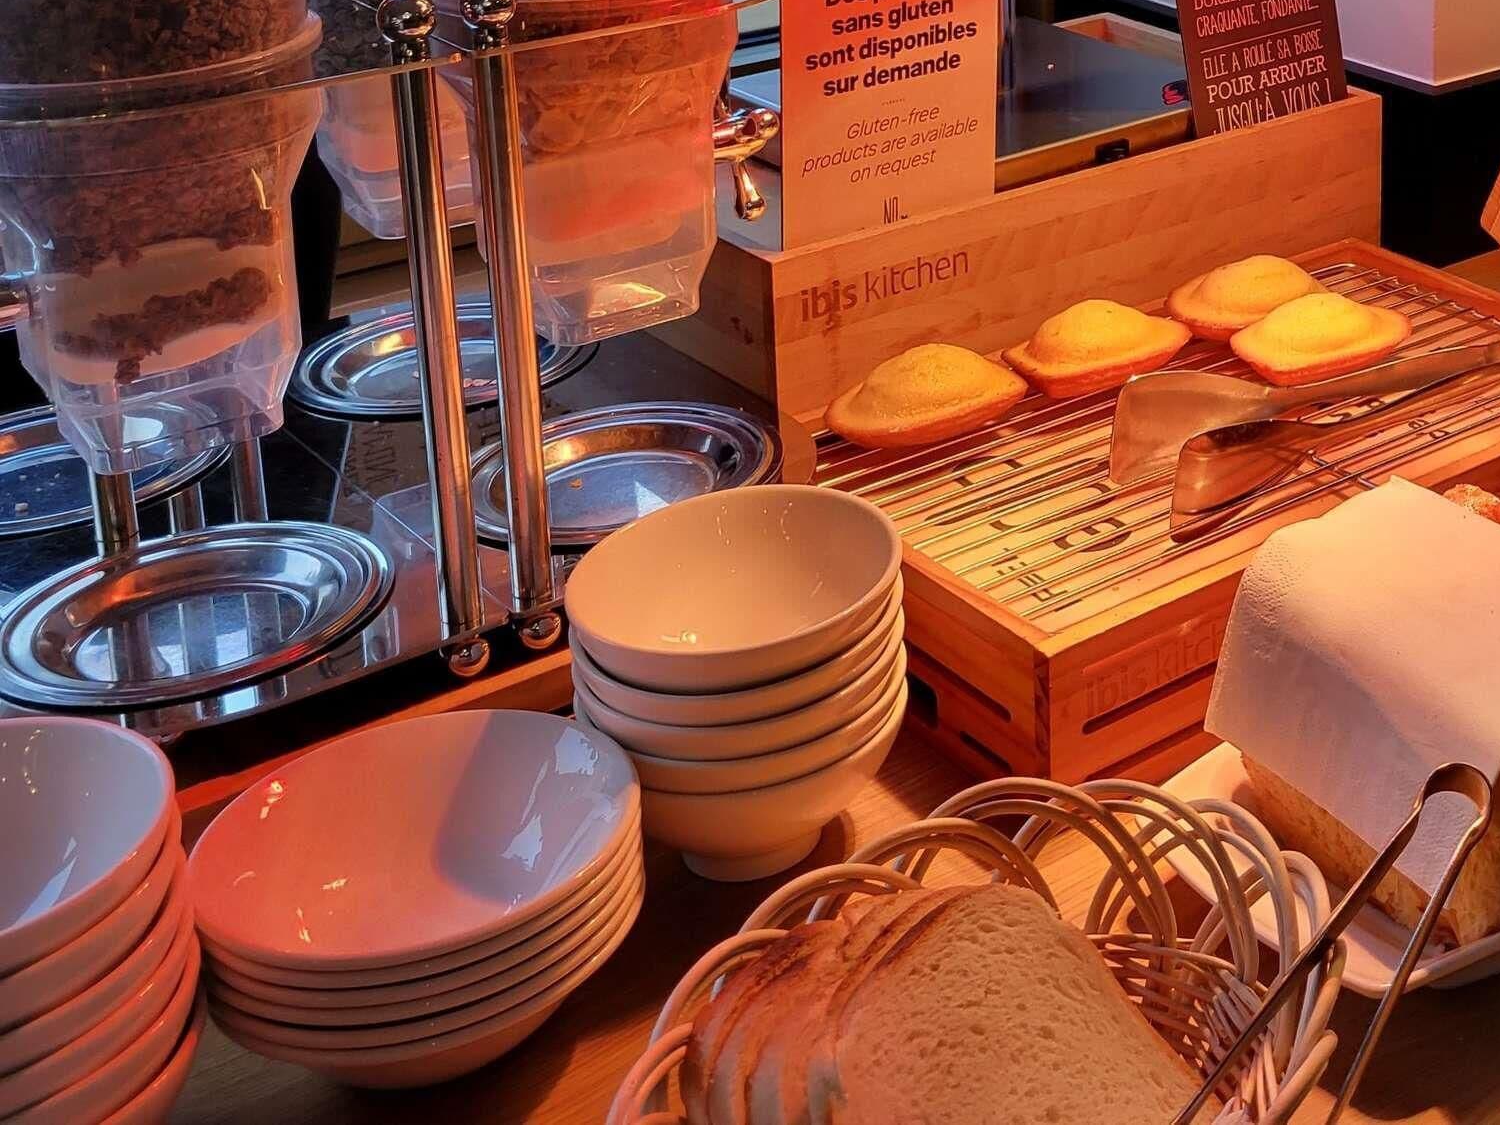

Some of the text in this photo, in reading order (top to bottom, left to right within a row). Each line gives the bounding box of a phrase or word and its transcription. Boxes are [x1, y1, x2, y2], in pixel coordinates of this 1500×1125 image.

[805, 19, 978, 71] sont disponibles
[831, 12, 883, 36] sans
[1196, 6, 1260, 38] CRAQUANTE,
[823, 51, 961, 97] sur demande
[1203, 29, 1324, 80] ELLE A ROULÉ SA BOSSE
[1206, 55, 1327, 104] POUR ARRIVER
[847, 104, 940, 140] Gluten-free
[801, 116, 978, 177] products are available
[849, 150, 937, 183] on request
[800, 250, 969, 323] ibis kitchen
